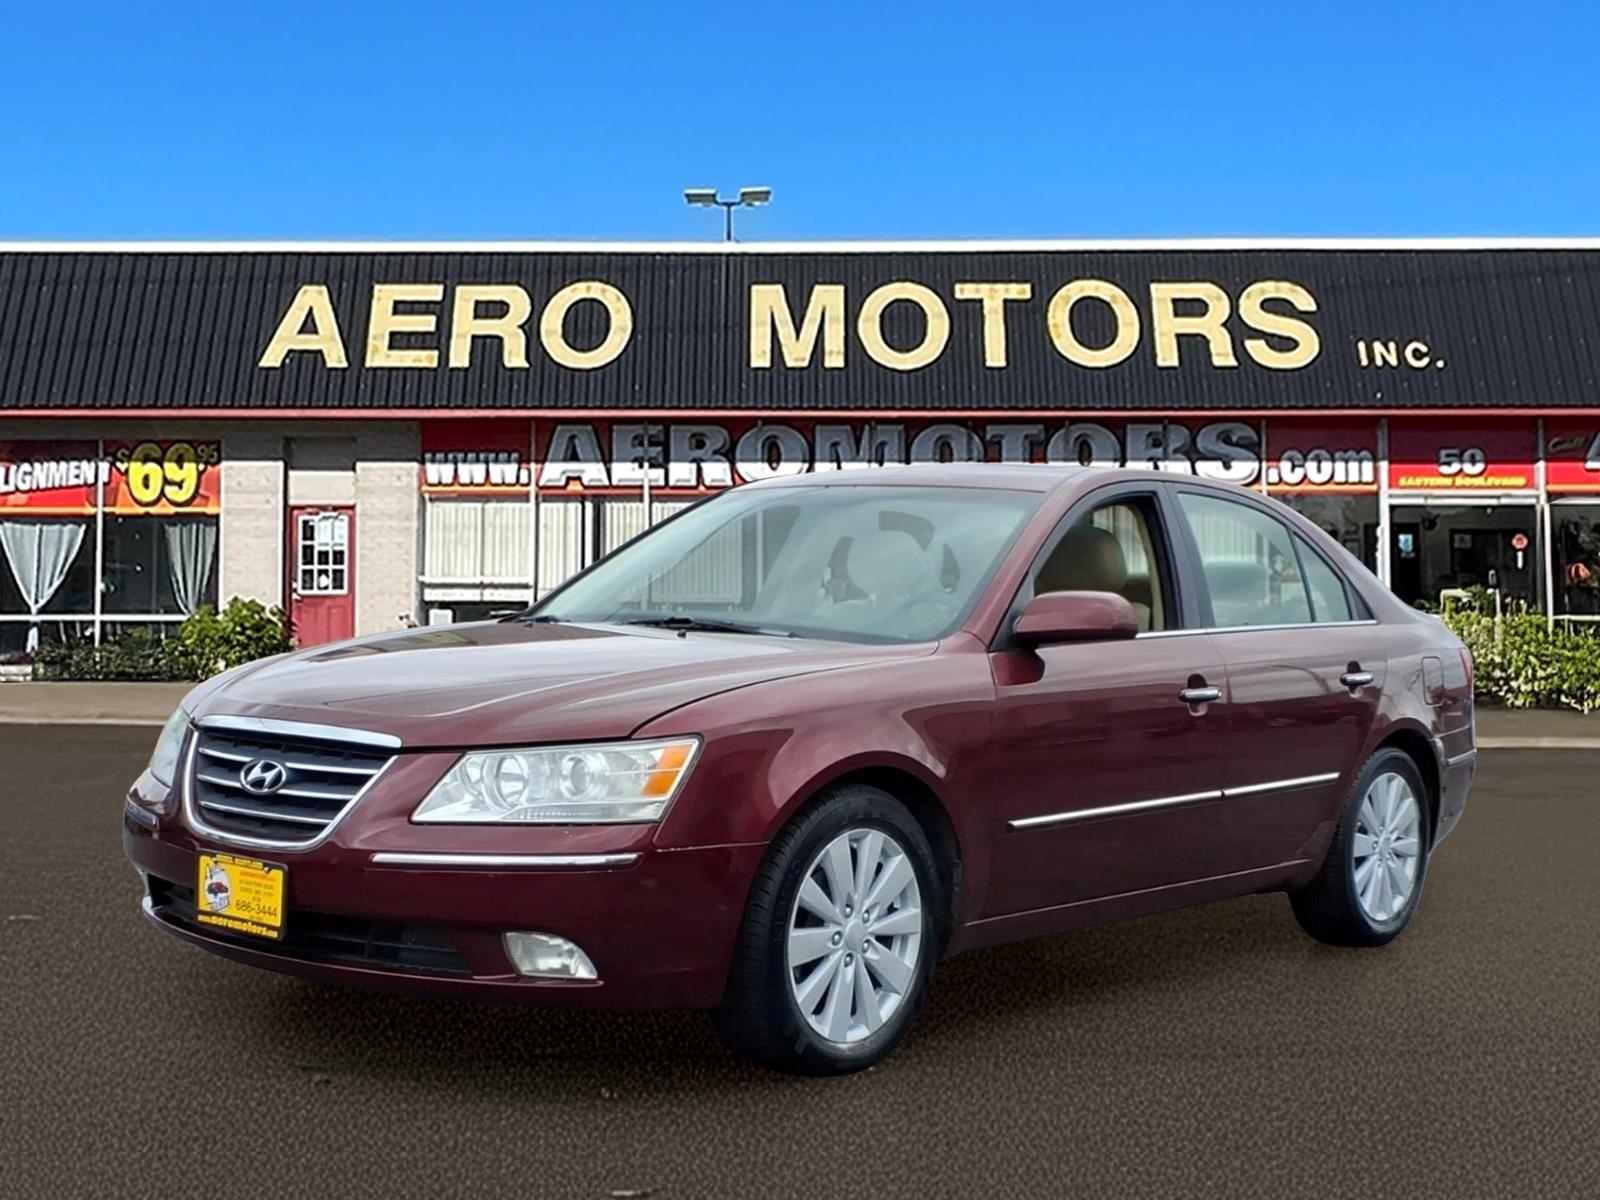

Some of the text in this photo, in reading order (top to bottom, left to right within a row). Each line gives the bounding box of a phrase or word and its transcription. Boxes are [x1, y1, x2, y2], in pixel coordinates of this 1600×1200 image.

[258, 279, 1446, 370] AERO MOTORS INC.
[1437, 448, 1486, 475] 50
[235, 899, 278, 918] 686-3444
